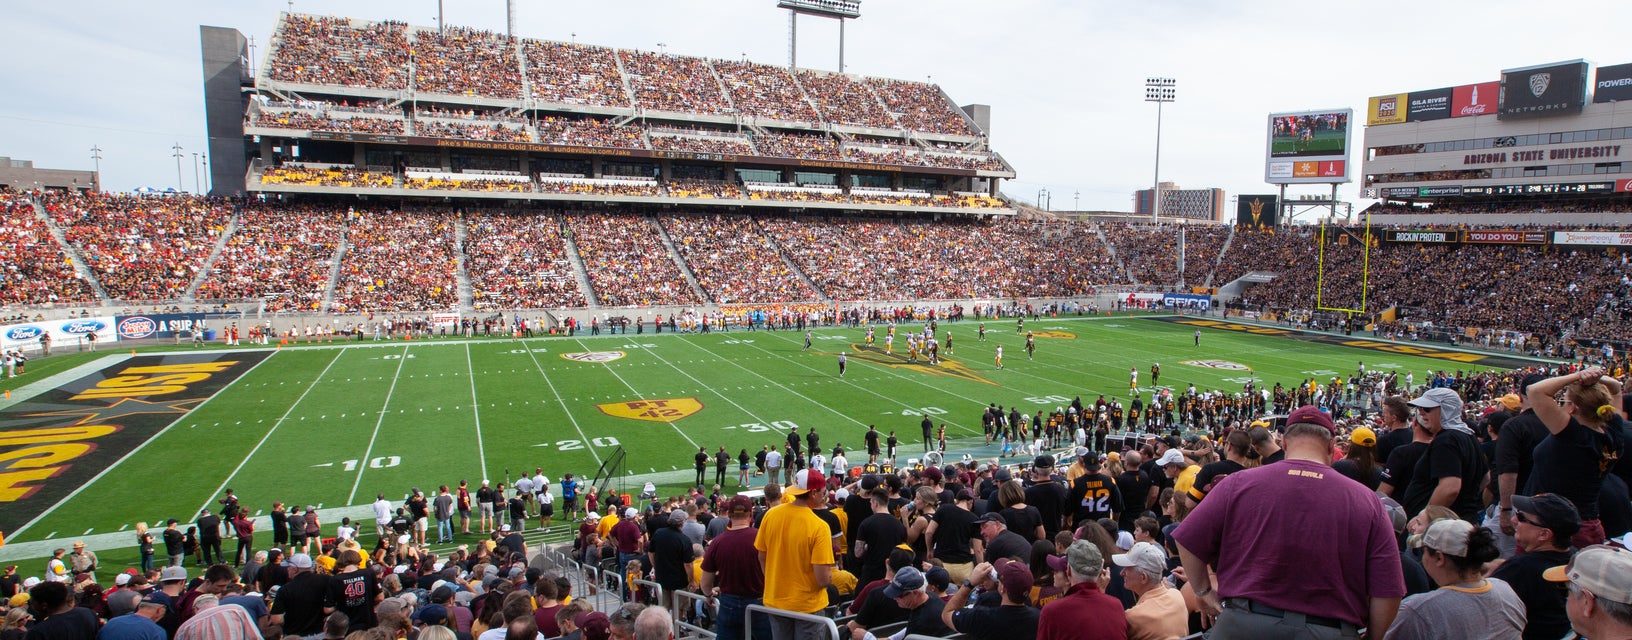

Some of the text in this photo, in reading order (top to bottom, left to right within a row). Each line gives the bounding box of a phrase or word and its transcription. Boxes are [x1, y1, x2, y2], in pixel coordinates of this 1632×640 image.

[1380, 102, 1395, 111] ASU
[1460, 104, 1486, 115] Coca-Cola
[1508, 102, 1567, 114] NETWORKS
[463, 141, 491, 149] Maroon
[493, 142, 506, 150] and
[508, 143, 526, 151] Gold
[528, 144, 549, 152] Ticket
[1464, 145, 1621, 165] ARIZONA STATE UNIVERSITY
[801, 160, 825, 168] Courtesy
[1423, 188, 1459, 197] enterprise
[1420, 232, 1446, 242] PROTEIN
[1164, 297, 1209, 307] GEICO
[69, 321, 98, 333] Ford
[159, 320, 167, 331] A
[11, 327, 36, 339] Ford
[626, 400, 668, 409] PT
[1024, 394, 1073, 405] 50
[901, 407, 949, 417] 40
[740, 420, 799, 434] 30
[556, 436, 620, 451] 20
[341, 456, 401, 471] 10
[1081, 488, 1110, 512] 42
[343, 576, 365, 584] TILLMAN
[344, 581, 365, 596] 40
